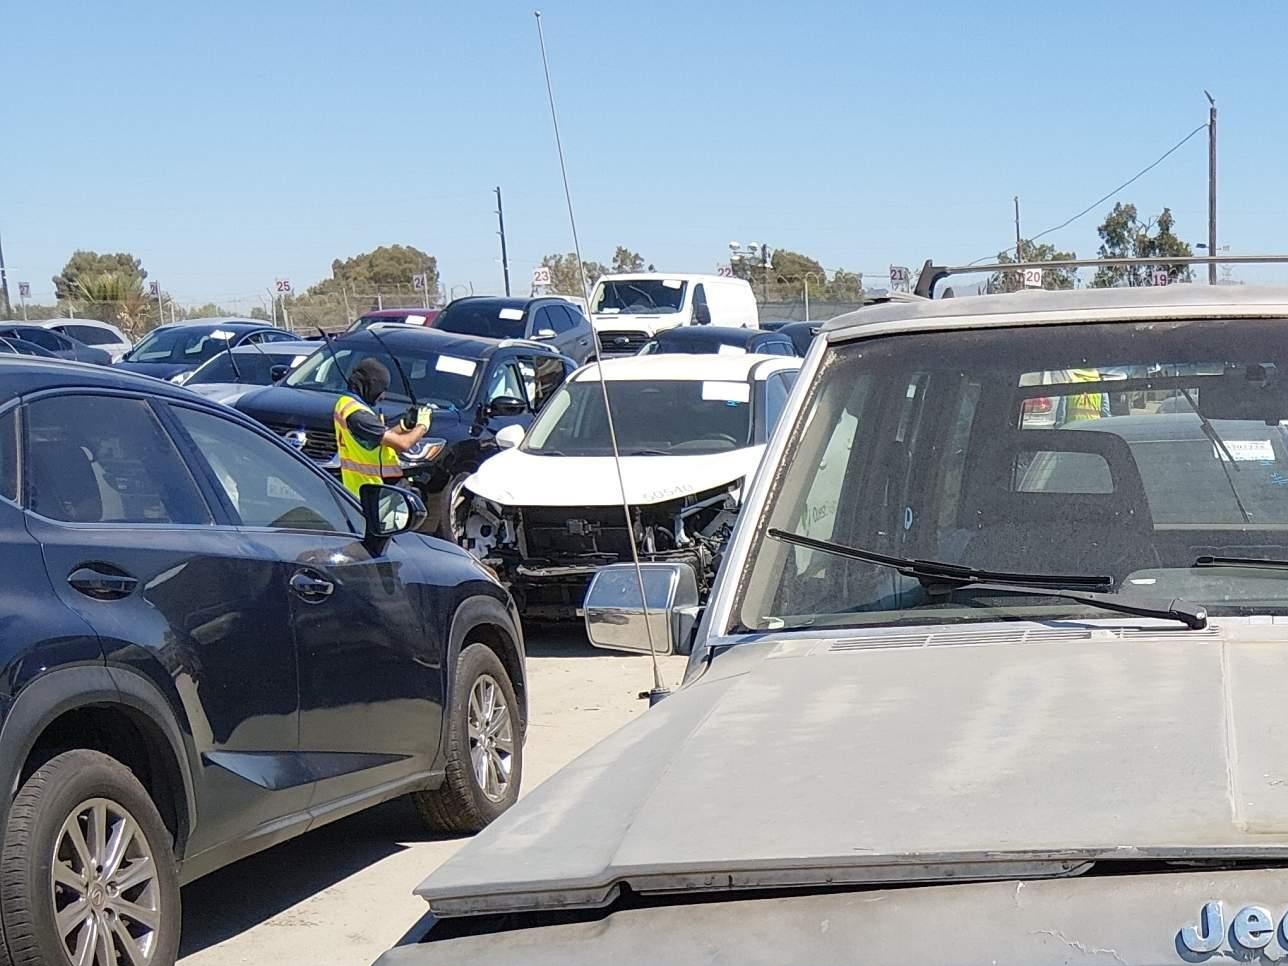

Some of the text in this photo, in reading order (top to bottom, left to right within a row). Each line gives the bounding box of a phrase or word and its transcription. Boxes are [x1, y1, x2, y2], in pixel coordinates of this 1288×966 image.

[534, 271, 549, 282] 23
[718, 267, 732, 278] 22
[890, 269, 904, 281] 21
[1026, 271, 1041, 283] 20
[1153, 274, 1168, 286] 19
[19, 284, 30, 296] 27
[276, 281, 290, 292] 25
